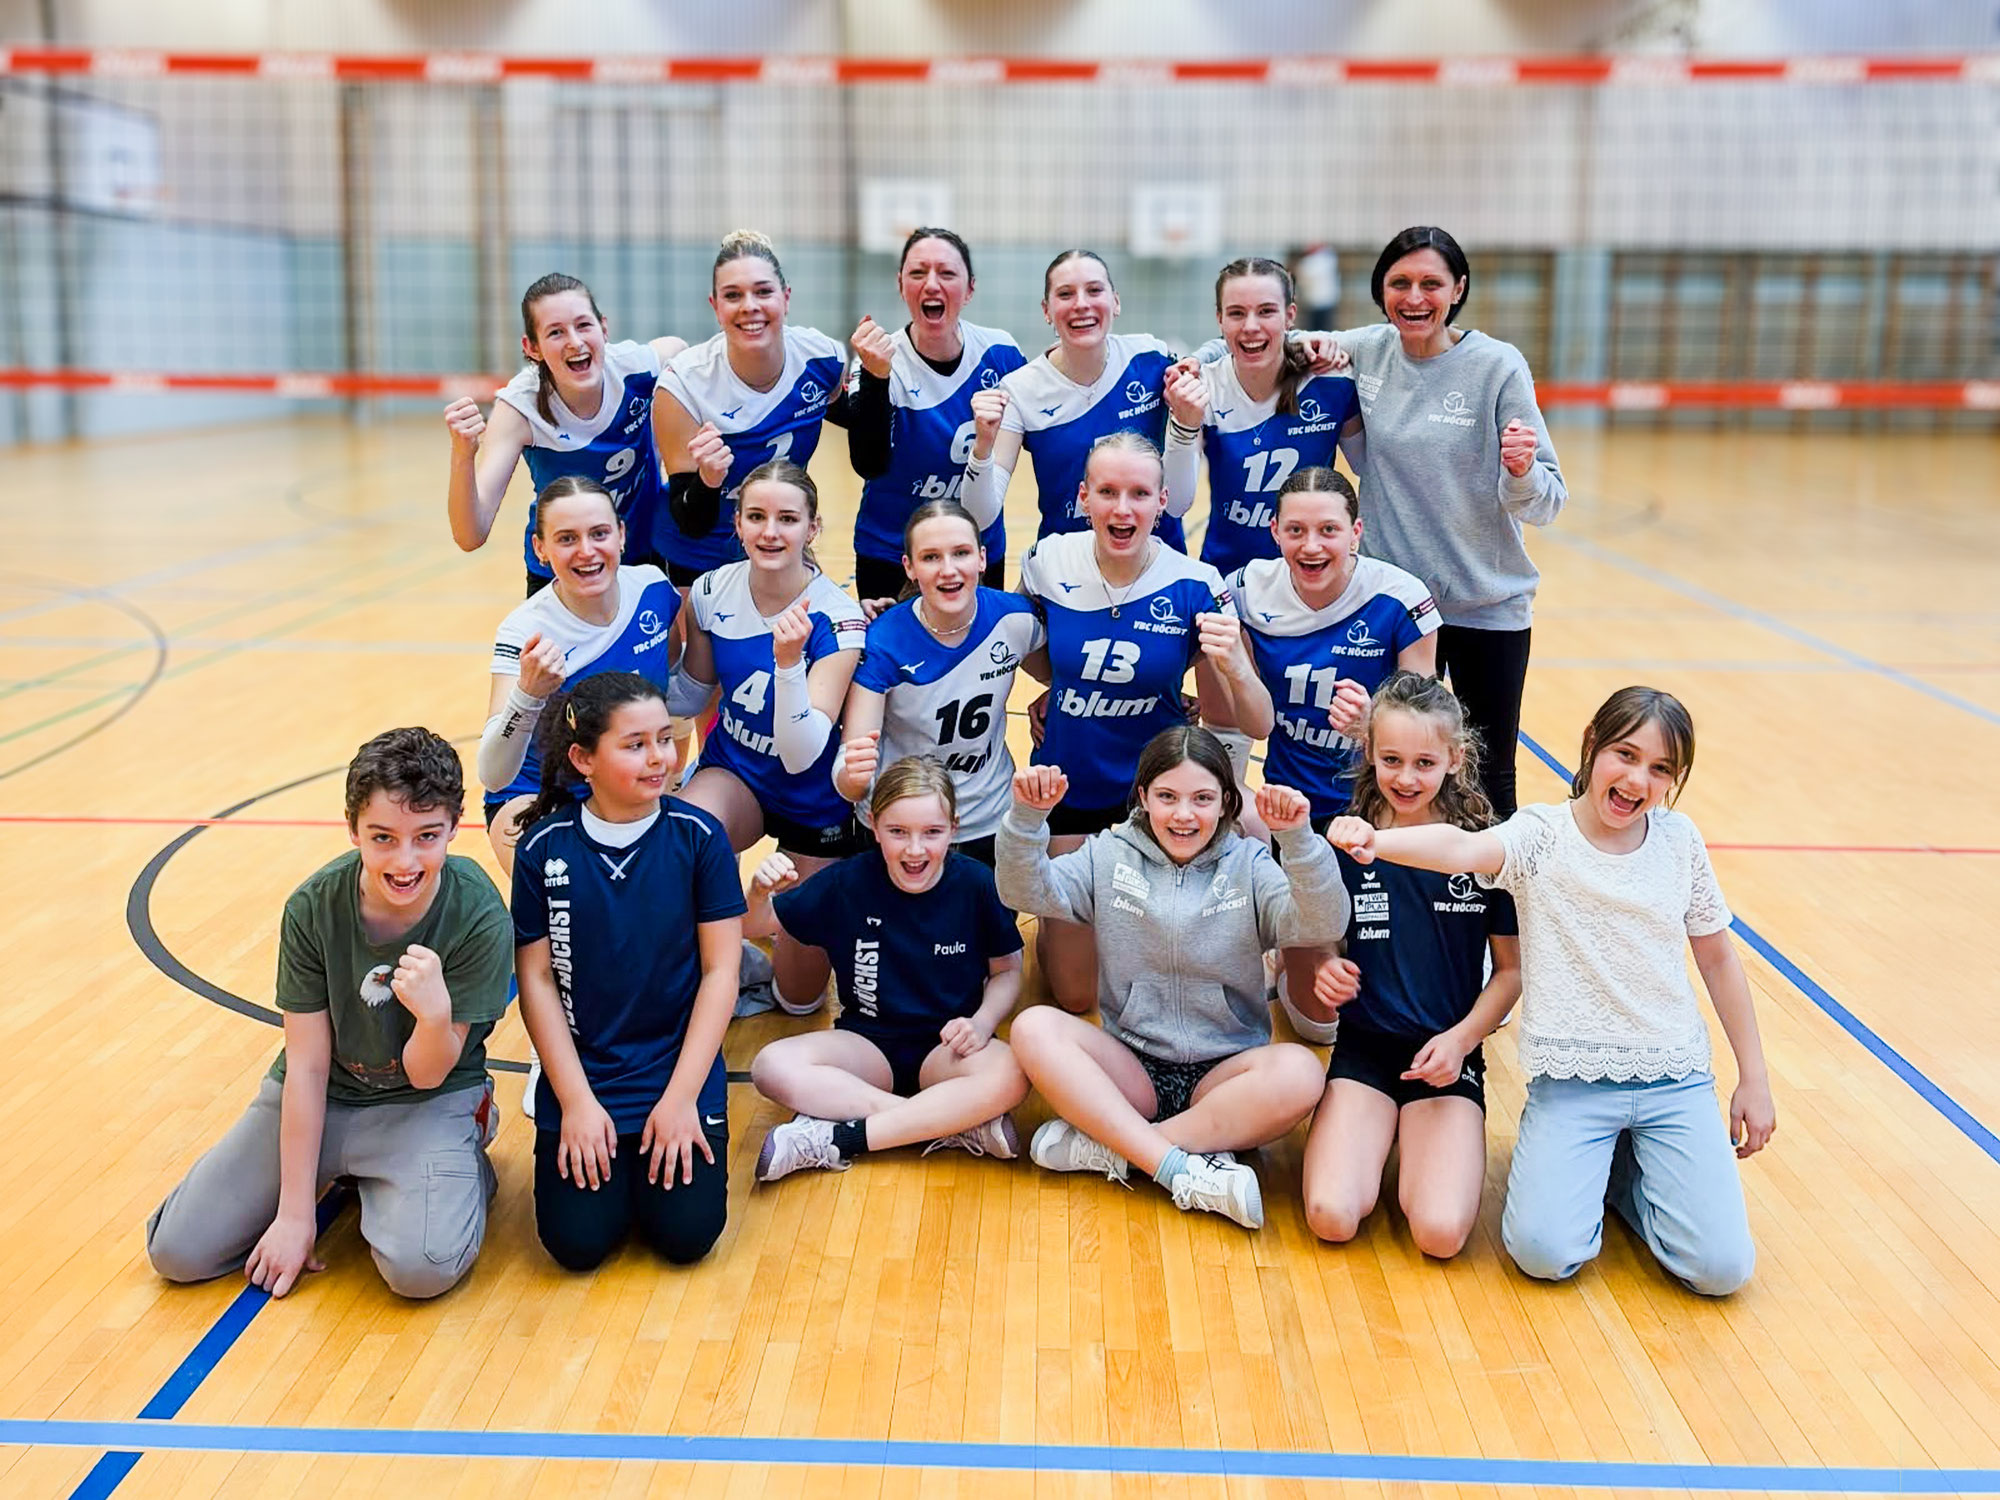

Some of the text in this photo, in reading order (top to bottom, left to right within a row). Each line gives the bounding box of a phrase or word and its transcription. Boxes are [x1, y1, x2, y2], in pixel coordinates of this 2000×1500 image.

[602, 447, 636, 484] 9
[1243, 447, 1300, 493] 12
[1227, 499, 1272, 528] blu
[1133, 620, 1152, 632] VBC
[1080, 637, 1141, 684] 13
[1347, 647, 1386, 657] HÖCHST
[980, 670, 996, 681] VBC
[1284, 663, 1338, 711] 11
[732, 669, 772, 715] 4
[1060, 687, 1160, 719] blum
[935, 693, 994, 746] 16
[1112, 896, 1145, 917] blum
[1433, 901, 1487, 914] VBC HÖCHST
[1360, 927, 1391, 940] blum
[934, 941, 967, 956] Paula
